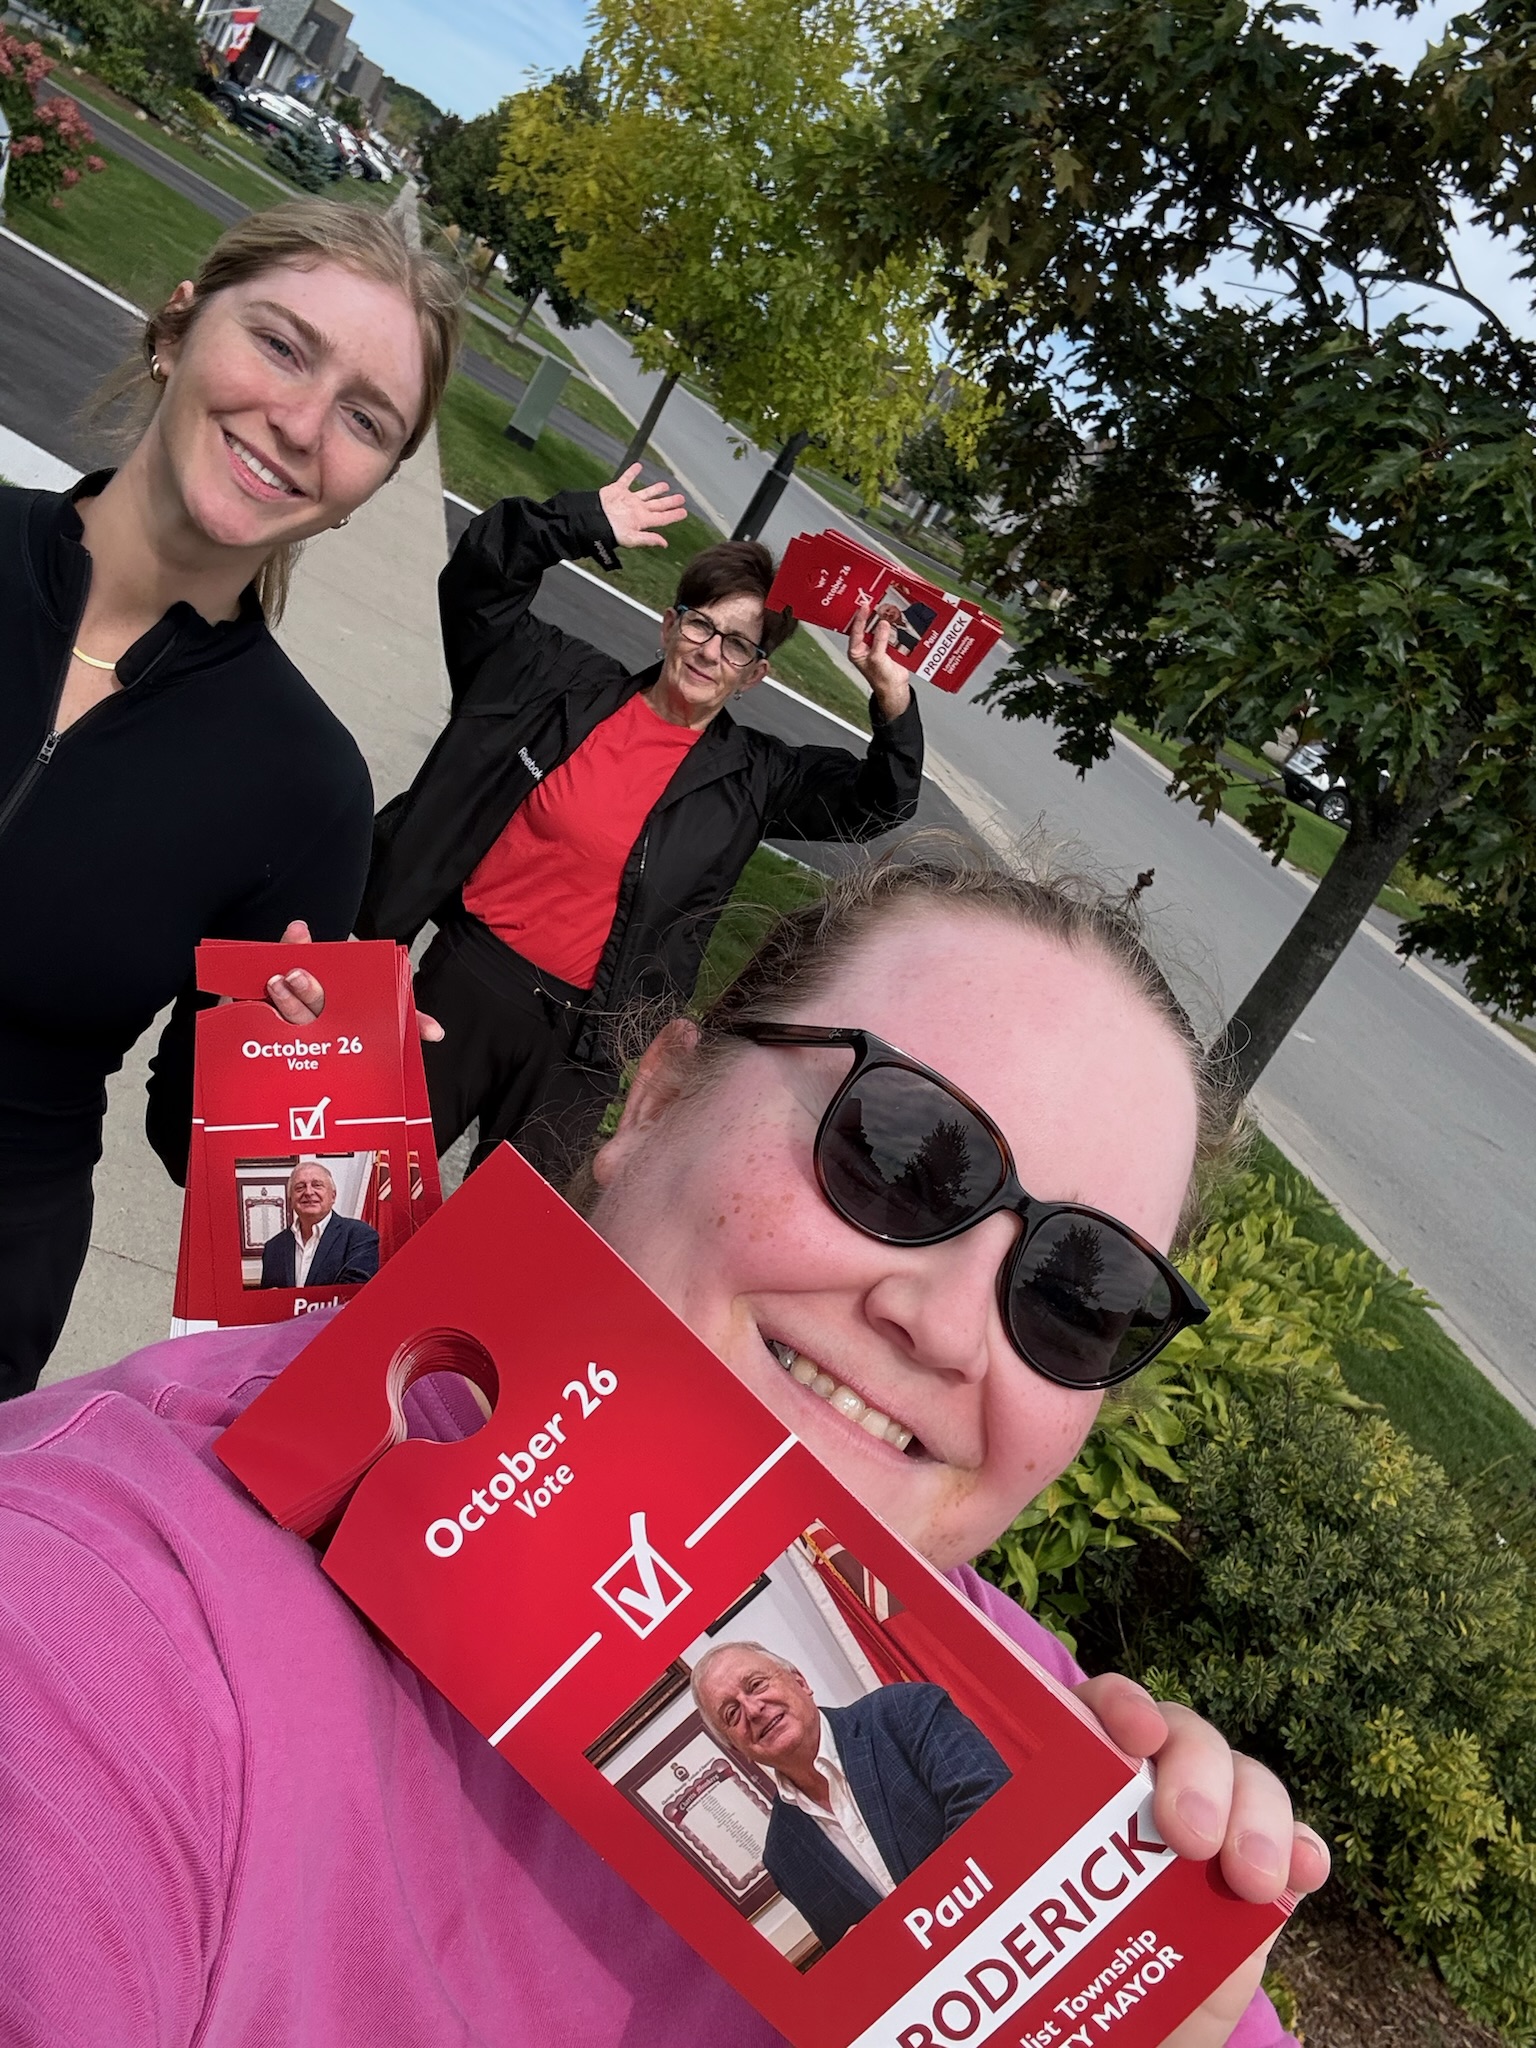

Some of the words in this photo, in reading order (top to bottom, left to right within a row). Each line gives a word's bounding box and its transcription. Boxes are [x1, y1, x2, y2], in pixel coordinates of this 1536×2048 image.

[821, 576, 845, 606] October
[839, 565, 851, 576] 26
[923, 629, 940, 649] Paul
[923, 617, 968, 677] PRODERICK
[517, 746, 544, 781] Reebok
[242, 1038, 332, 1059] October
[337, 1036, 363, 1055] 26
[287, 1058, 319, 1071] Vote
[424, 1412, 567, 1558] October
[562, 1362, 618, 1420] 26
[513, 1464, 575, 1519] Vote
[903, 1856, 994, 1950] Paul
[1053, 1930, 1157, 2021] Township
[1091, 1945, 1184, 2032] MAYOR
